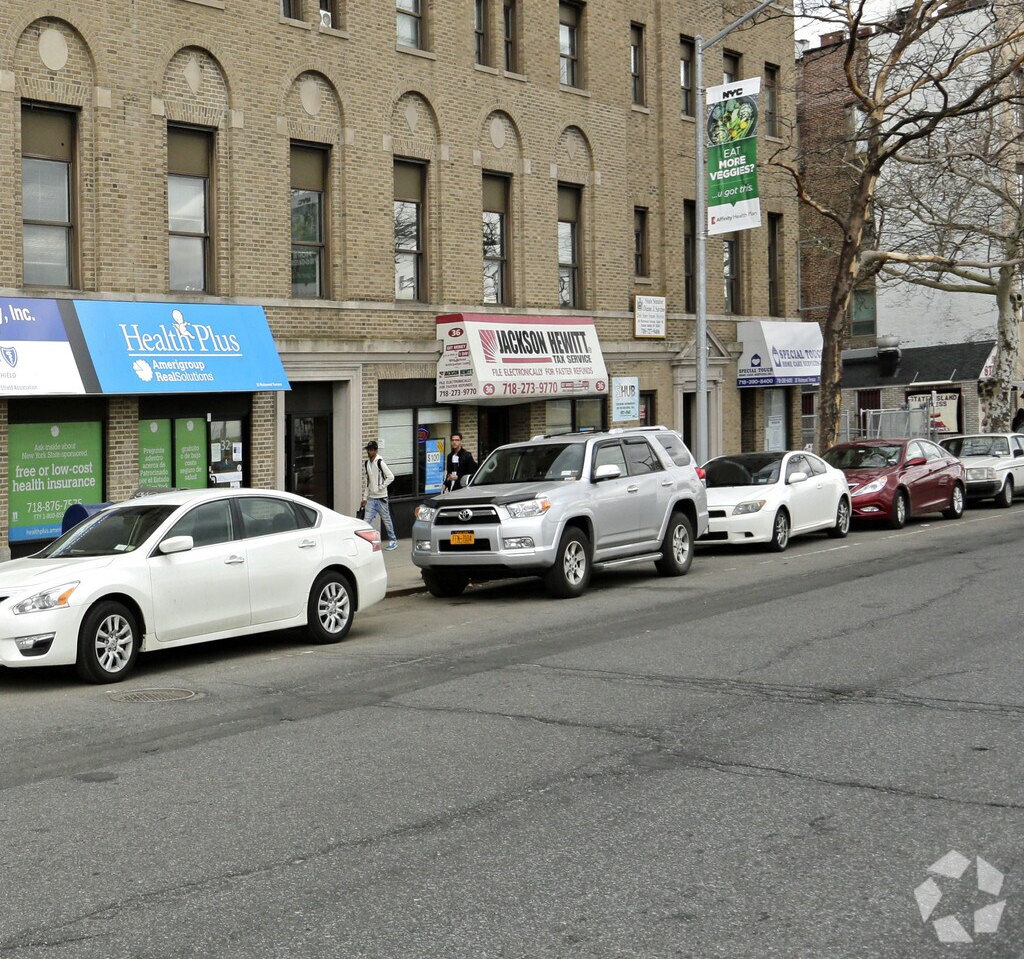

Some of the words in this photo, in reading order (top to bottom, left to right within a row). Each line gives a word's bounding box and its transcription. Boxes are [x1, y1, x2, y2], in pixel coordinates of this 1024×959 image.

[722, 88, 743, 99] NYC
[723, 146, 741, 158] EAT
[719, 155, 746, 170] MORE
[709, 163, 755, 181] VEGGIES?
[724, 187, 738, 198] got
[716, 215, 732, 223] Affinity
[733, 212, 747, 220] Health
[9, 304, 36, 322] Inc.
[118, 323, 195, 352] Health
[191, 324, 241, 352] Plus
[451, 328, 461, 337] 36
[496, 330, 549, 355] JACKSON
[547, 331, 589, 354] HEWITT
[552, 355, 566, 364] TAX
[567, 355, 593, 364] SERVICE
[779, 349, 805, 359] SPECIAL
[804, 349, 822, 359] TOUC
[152, 359, 206, 372] Amerigroup
[155, 371, 214, 383] RealSolutions
[492, 368, 502, 377] FILE
[504, 368, 543, 376] ELECTRONICALLY
[556, 367, 573, 375] FASTER
[573, 367, 594, 375] REFUNDS
[502, 382, 558, 395] 718-273-9770
[45, 443, 61, 451] inside
[61, 442, 76, 450] about
[181, 445, 200, 453] gratuito
[220, 439, 230, 451] 32
[21, 452, 34, 460] New
[143, 447, 165, 455] Pregunte
[15, 465, 36, 478] free
[38, 466, 50, 476] or
[51, 461, 93, 476] low-cost
[139, 468, 169, 476] Patrocinado
[12, 478, 45, 492] health
[47, 477, 96, 490] insurance
[26, 527, 62, 535] healthplus.amer
